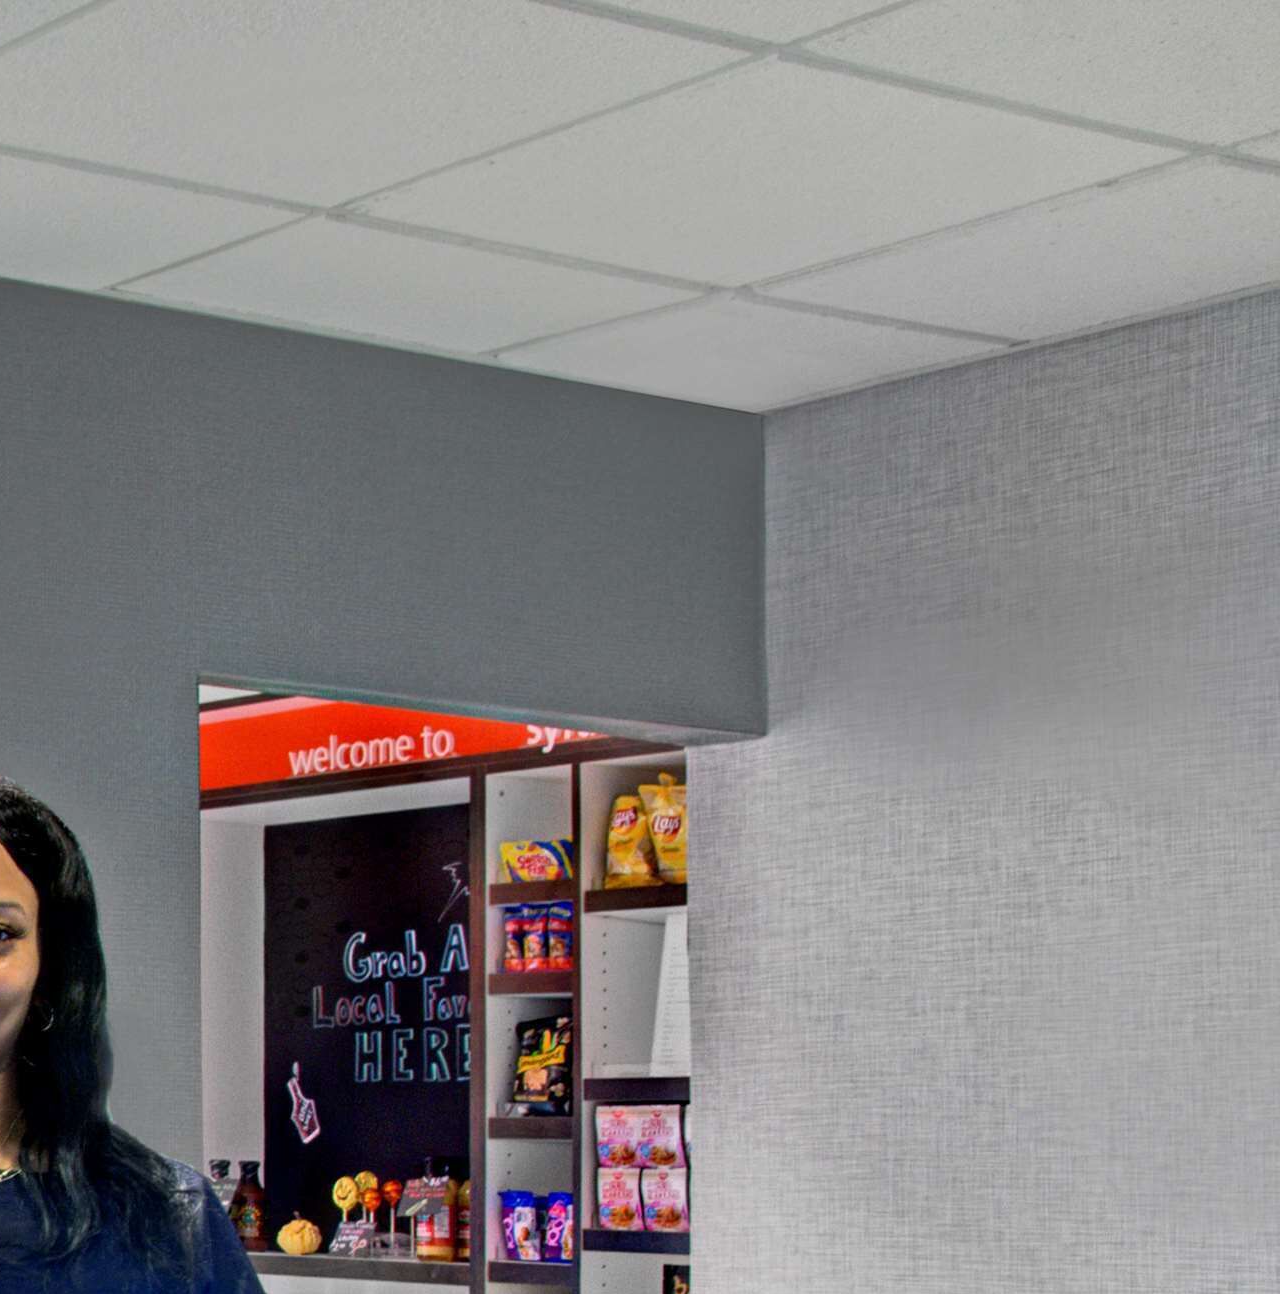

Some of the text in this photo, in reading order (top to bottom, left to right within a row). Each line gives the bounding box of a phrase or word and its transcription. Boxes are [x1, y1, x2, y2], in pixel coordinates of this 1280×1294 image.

[289, 725, 455, 776] welcome to
[343, 923, 470, 983] Grab A
[313, 976, 471, 1028] Local Fav
[355, 1023, 471, 1082] HERE
